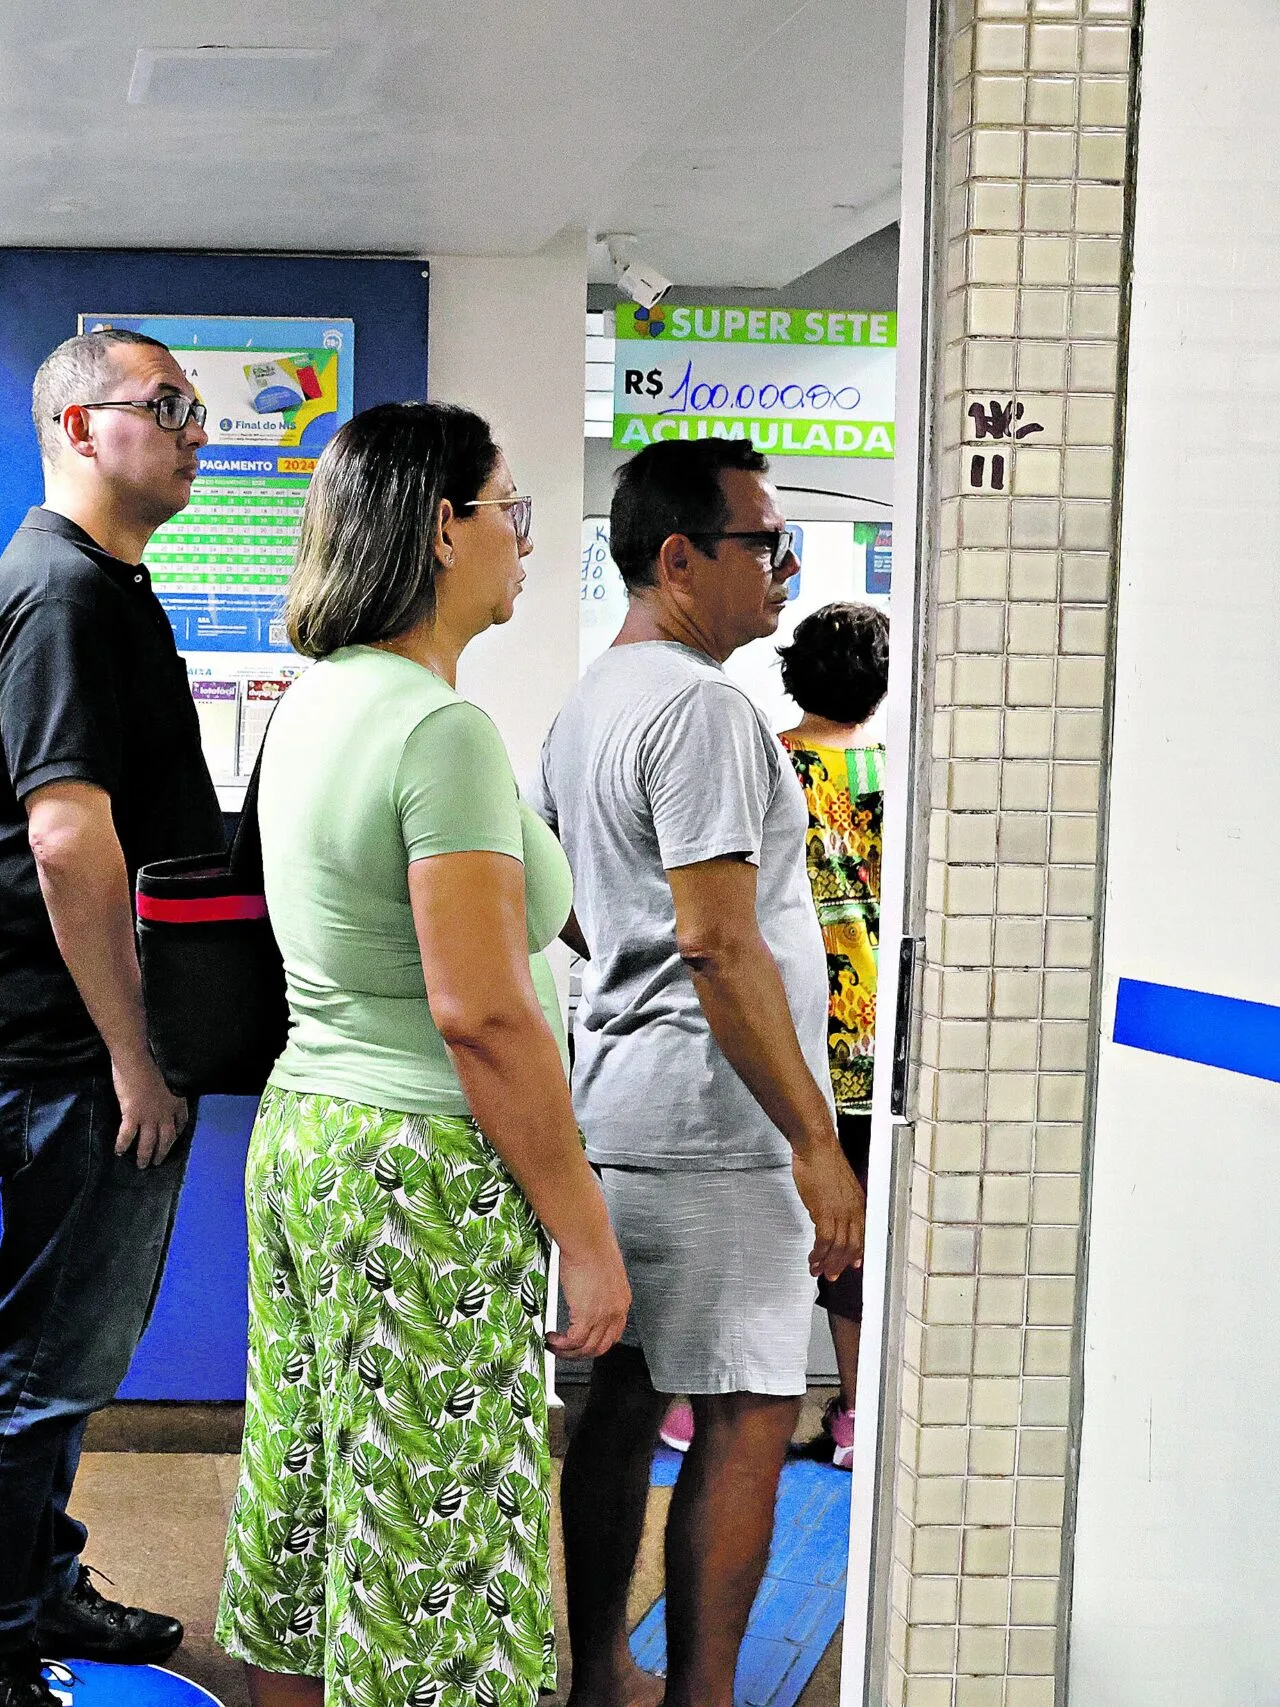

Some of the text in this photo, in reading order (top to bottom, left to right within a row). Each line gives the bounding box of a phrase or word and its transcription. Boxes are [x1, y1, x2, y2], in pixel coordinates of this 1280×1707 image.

[671, 308, 889, 344] SUPER SETE
[624, 368, 664, 399] R$
[235, 420, 261, 430] Final
[264, 420, 277, 430] do
[199, 459, 316, 472] PAGAMENTO 2024
